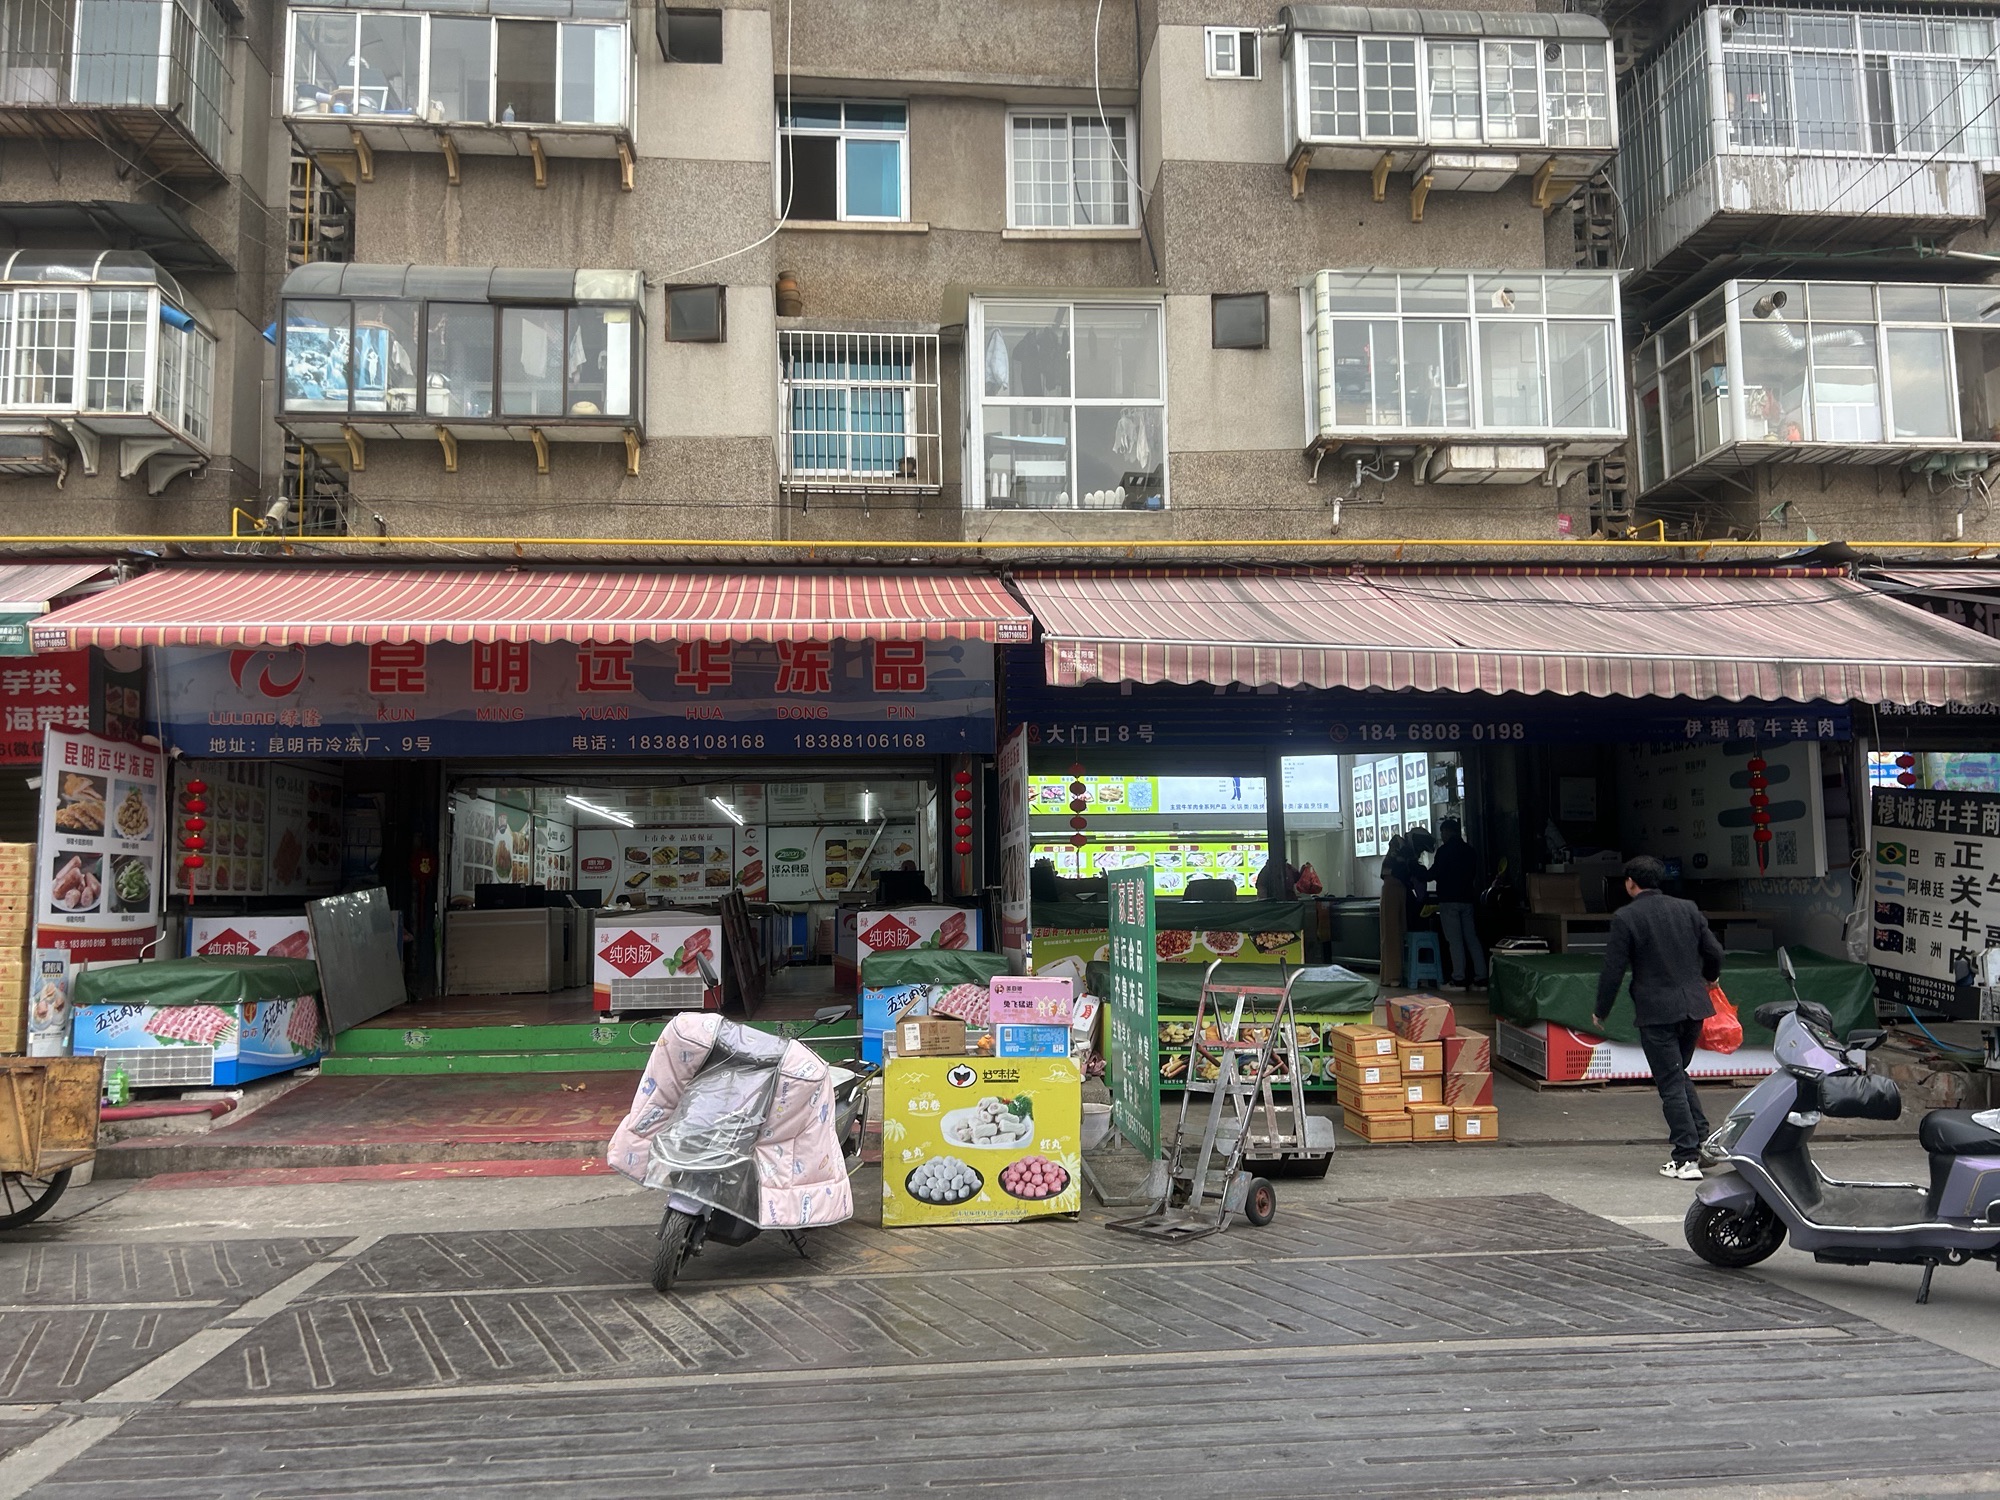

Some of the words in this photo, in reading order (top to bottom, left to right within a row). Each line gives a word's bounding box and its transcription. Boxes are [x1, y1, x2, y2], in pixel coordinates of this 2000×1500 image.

[368, 639, 926, 695] 昆明远华冻品
[279, 709, 323, 728] 绿隆
[377, 707, 415, 721] KUN
[476, 707, 525, 721] MING
[577, 707, 629, 721] YUAN
[685, 706, 724, 721] HUA
[777, 706, 829, 719] DONG
[887, 706, 916, 719] PIN
[1047, 725, 1155, 744] 大门口8号
[1358, 724, 1397, 741] 184
[1408, 724, 1461, 741] 6808
[1472, 723, 1525, 740] 0198
[1684, 718, 1835, 738] 伊瑞霞牛羊肉
[793, 733, 926, 749] 18388106168
[64, 741, 155, 779] 昆明远华冻品
[1909, 849, 1947, 868] 巴西
[1907, 878, 1945, 899] 阿根廷
[1905, 907, 1944, 929] 新西兰
[869, 928, 911, 948] 纯肉肠
[1905, 936, 1942, 959] 澳洲
[208, 941, 250, 956] 纯肉肠
[609, 944, 652, 964] 纯肉肠
[1003, 1000, 1033, 1008] 兔飞猛进
[982, 1068, 1020, 1080] 好味快
[907, 1099, 941, 1112] 鱼肉卷
[902, 1147, 924, 1159] 鱼丸
[1039, 1138, 1062, 1150] 虾丸
